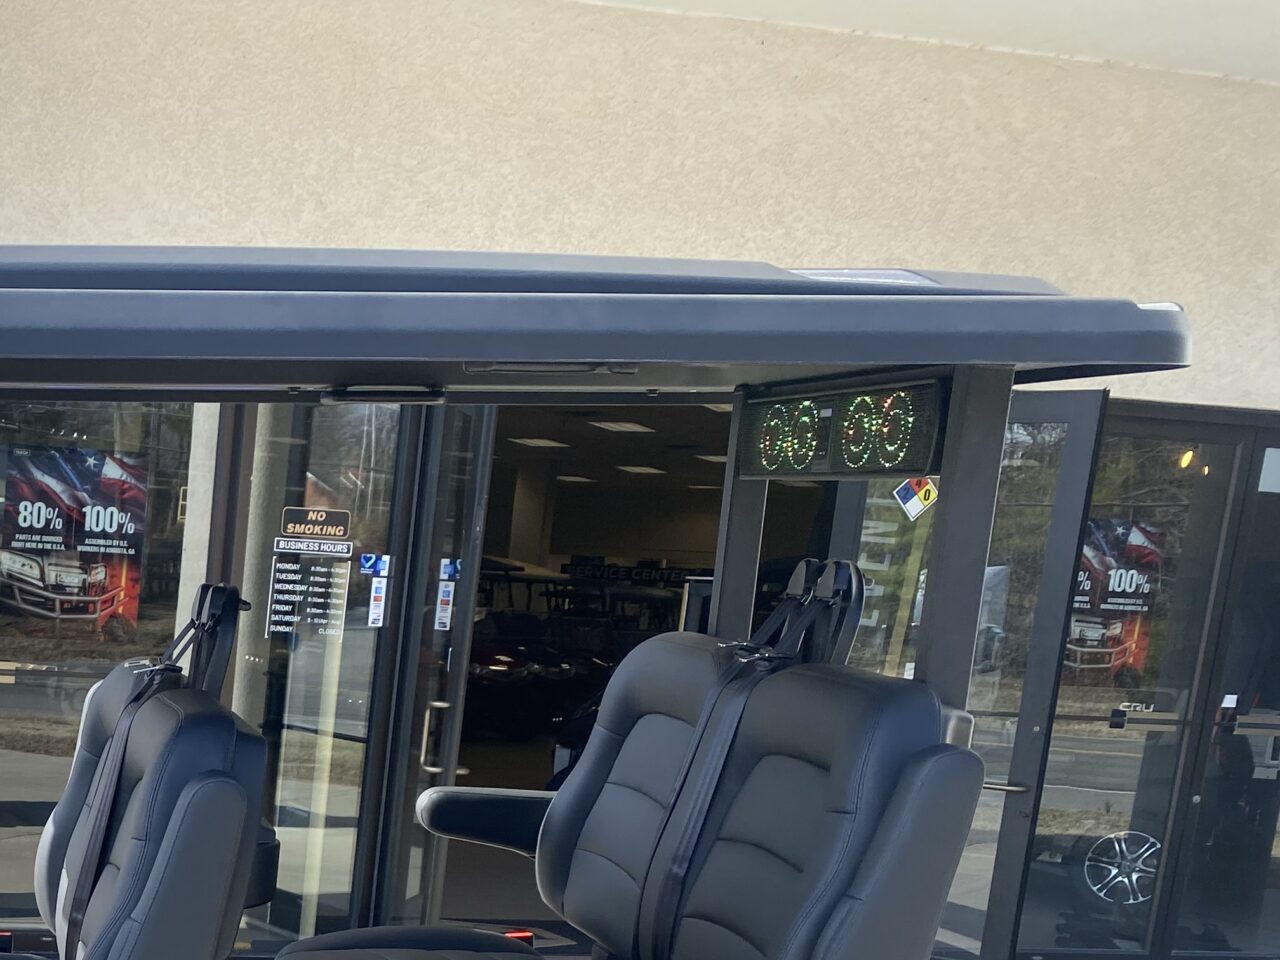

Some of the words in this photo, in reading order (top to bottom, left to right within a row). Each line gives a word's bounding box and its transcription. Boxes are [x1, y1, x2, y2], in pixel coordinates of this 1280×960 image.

[923, 488, 931, 501] 0
[18, 500, 63, 530] 80%
[82, 505, 135, 534] 100%
[307, 511, 327, 521] NO
[286, 523, 345, 536] SMOKING
[279, 540, 319, 551] BUSINESS
[320, 543, 348, 553] HOURS
[276, 562, 301, 571] MONDAY
[275, 572, 303, 581] TUESDAY
[1108, 568, 1151, 594] 100%
[274, 583, 308, 592] WEDNESDAY
[273, 593, 304, 602] THURSDAY
[272, 604, 293, 612] FRIDAY
[271, 614, 301, 623] SATURDAY
[270, 625, 294, 633] SUNDAY
[1119, 702, 1155, 712] CRU
